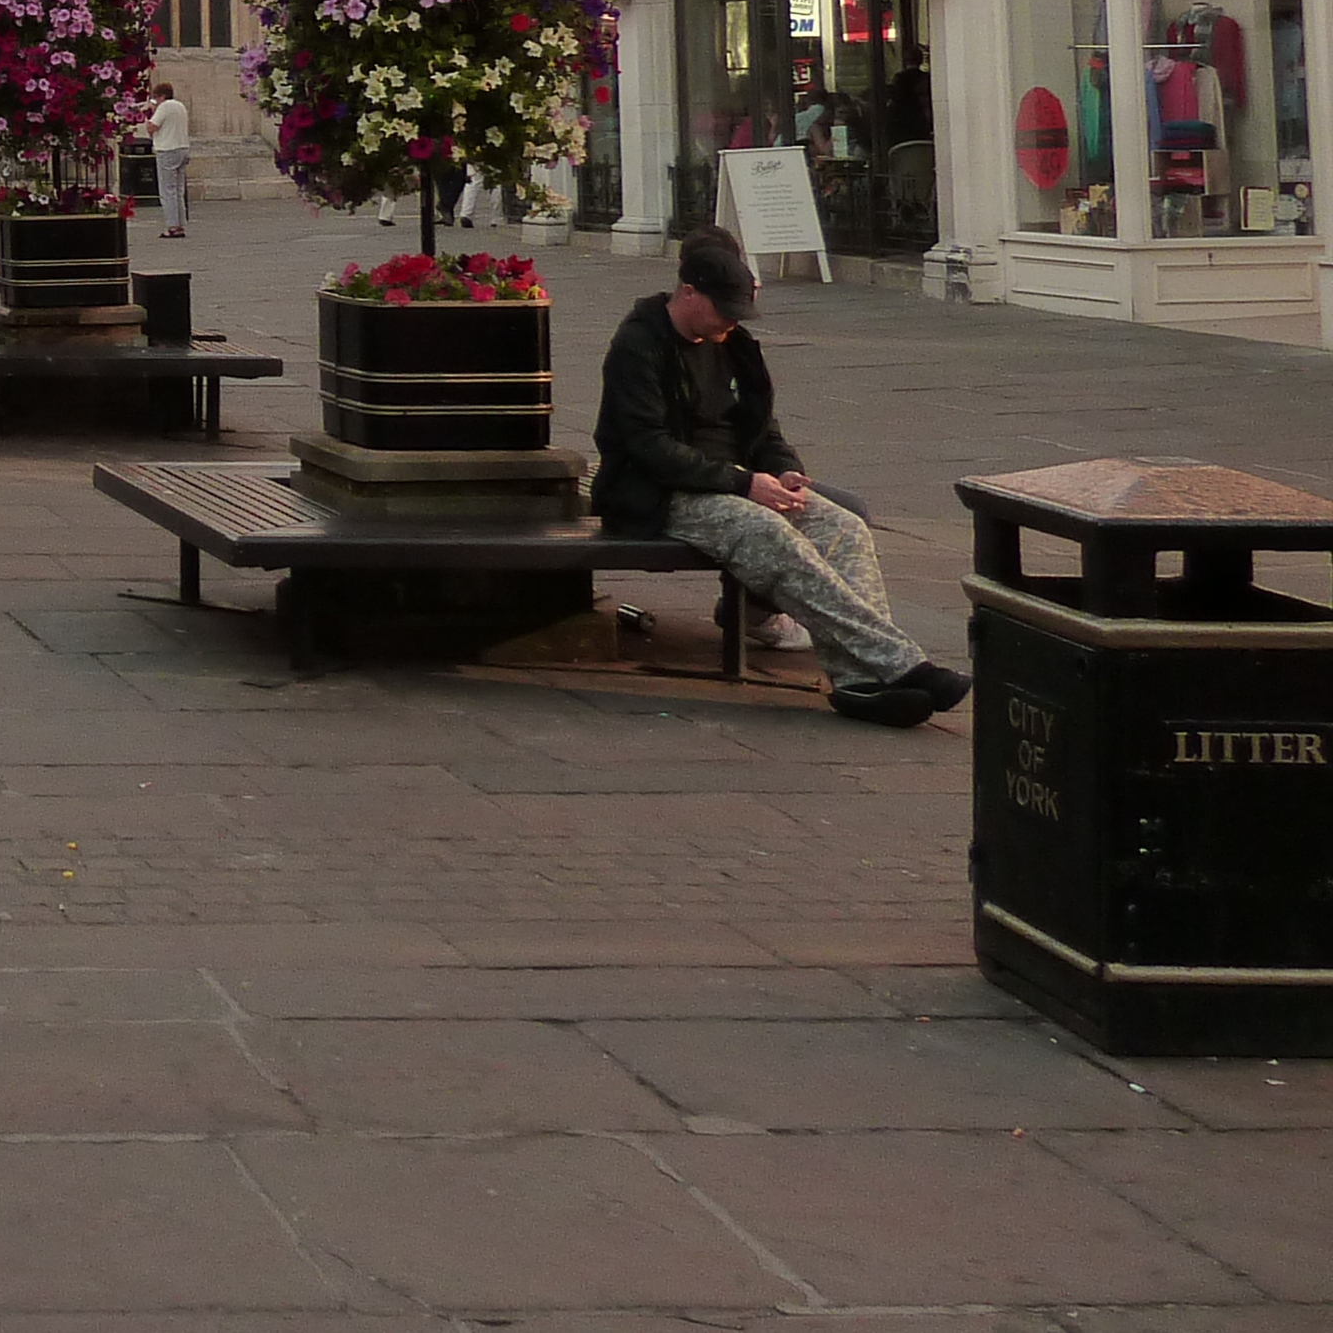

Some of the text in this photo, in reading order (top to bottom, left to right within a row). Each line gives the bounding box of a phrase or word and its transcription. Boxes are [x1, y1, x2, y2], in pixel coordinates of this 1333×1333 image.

[1008, 697, 1055, 743] CITY
[1018, 740, 1046, 773] OF
[1172, 731, 1327, 765] LITTER
[1005, 769, 1059, 821] YORK
